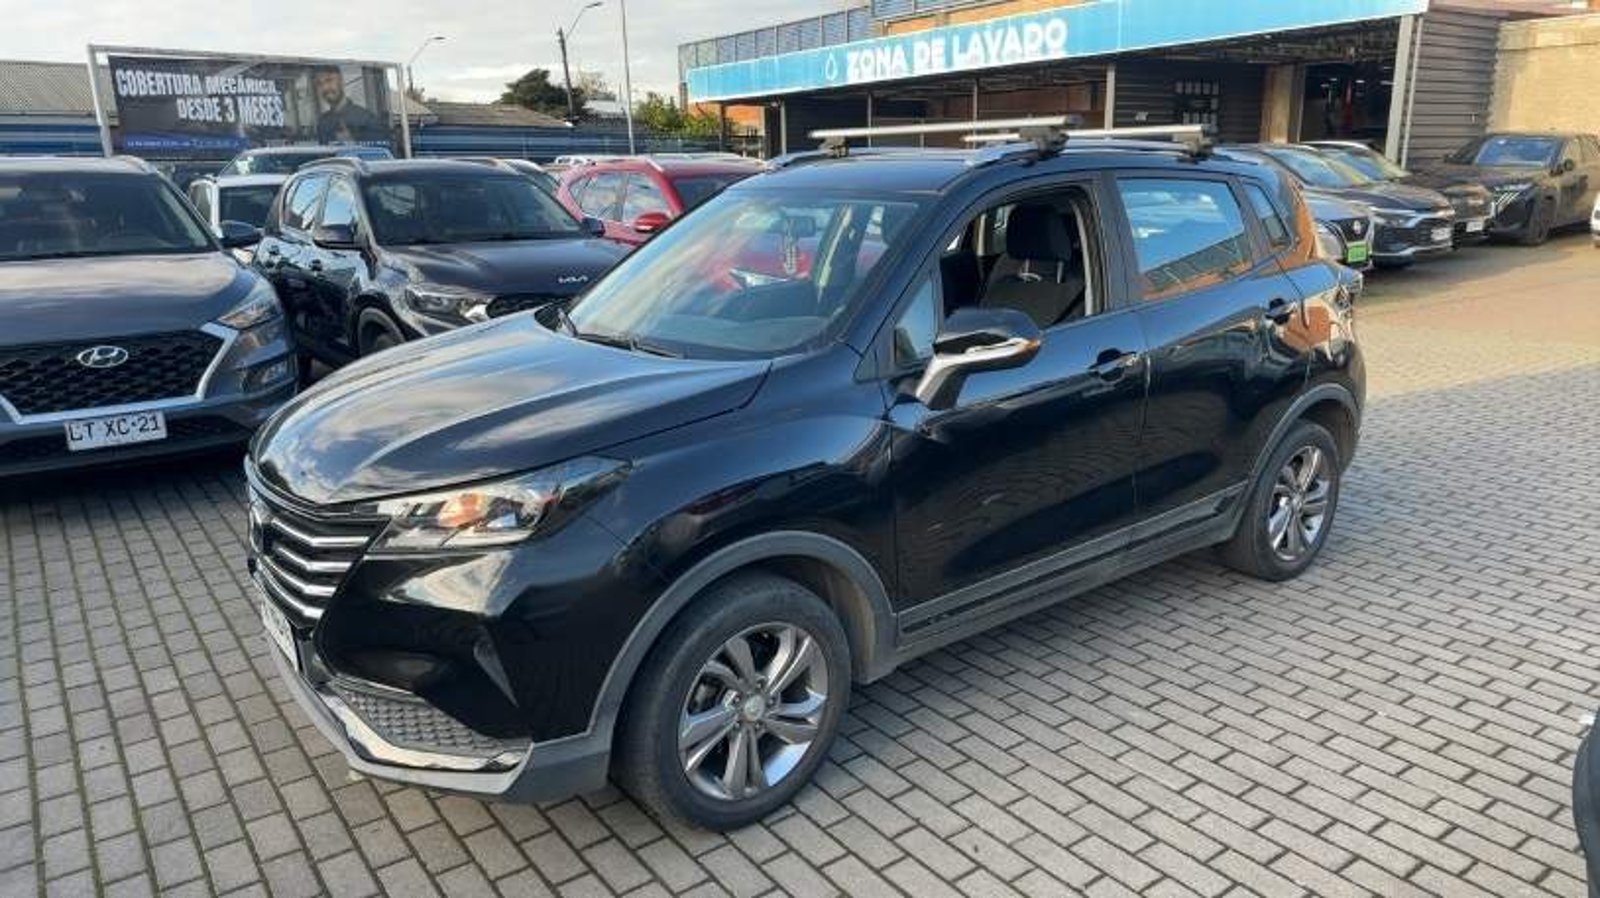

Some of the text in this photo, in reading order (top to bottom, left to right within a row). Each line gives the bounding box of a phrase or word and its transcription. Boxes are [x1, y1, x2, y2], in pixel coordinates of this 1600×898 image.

[846, 19, 1068, 84] ZONA DE LAVADO
[115, 69, 203, 97] COBERTURA
[176, 96, 284, 128] DESDE 3 MESES
